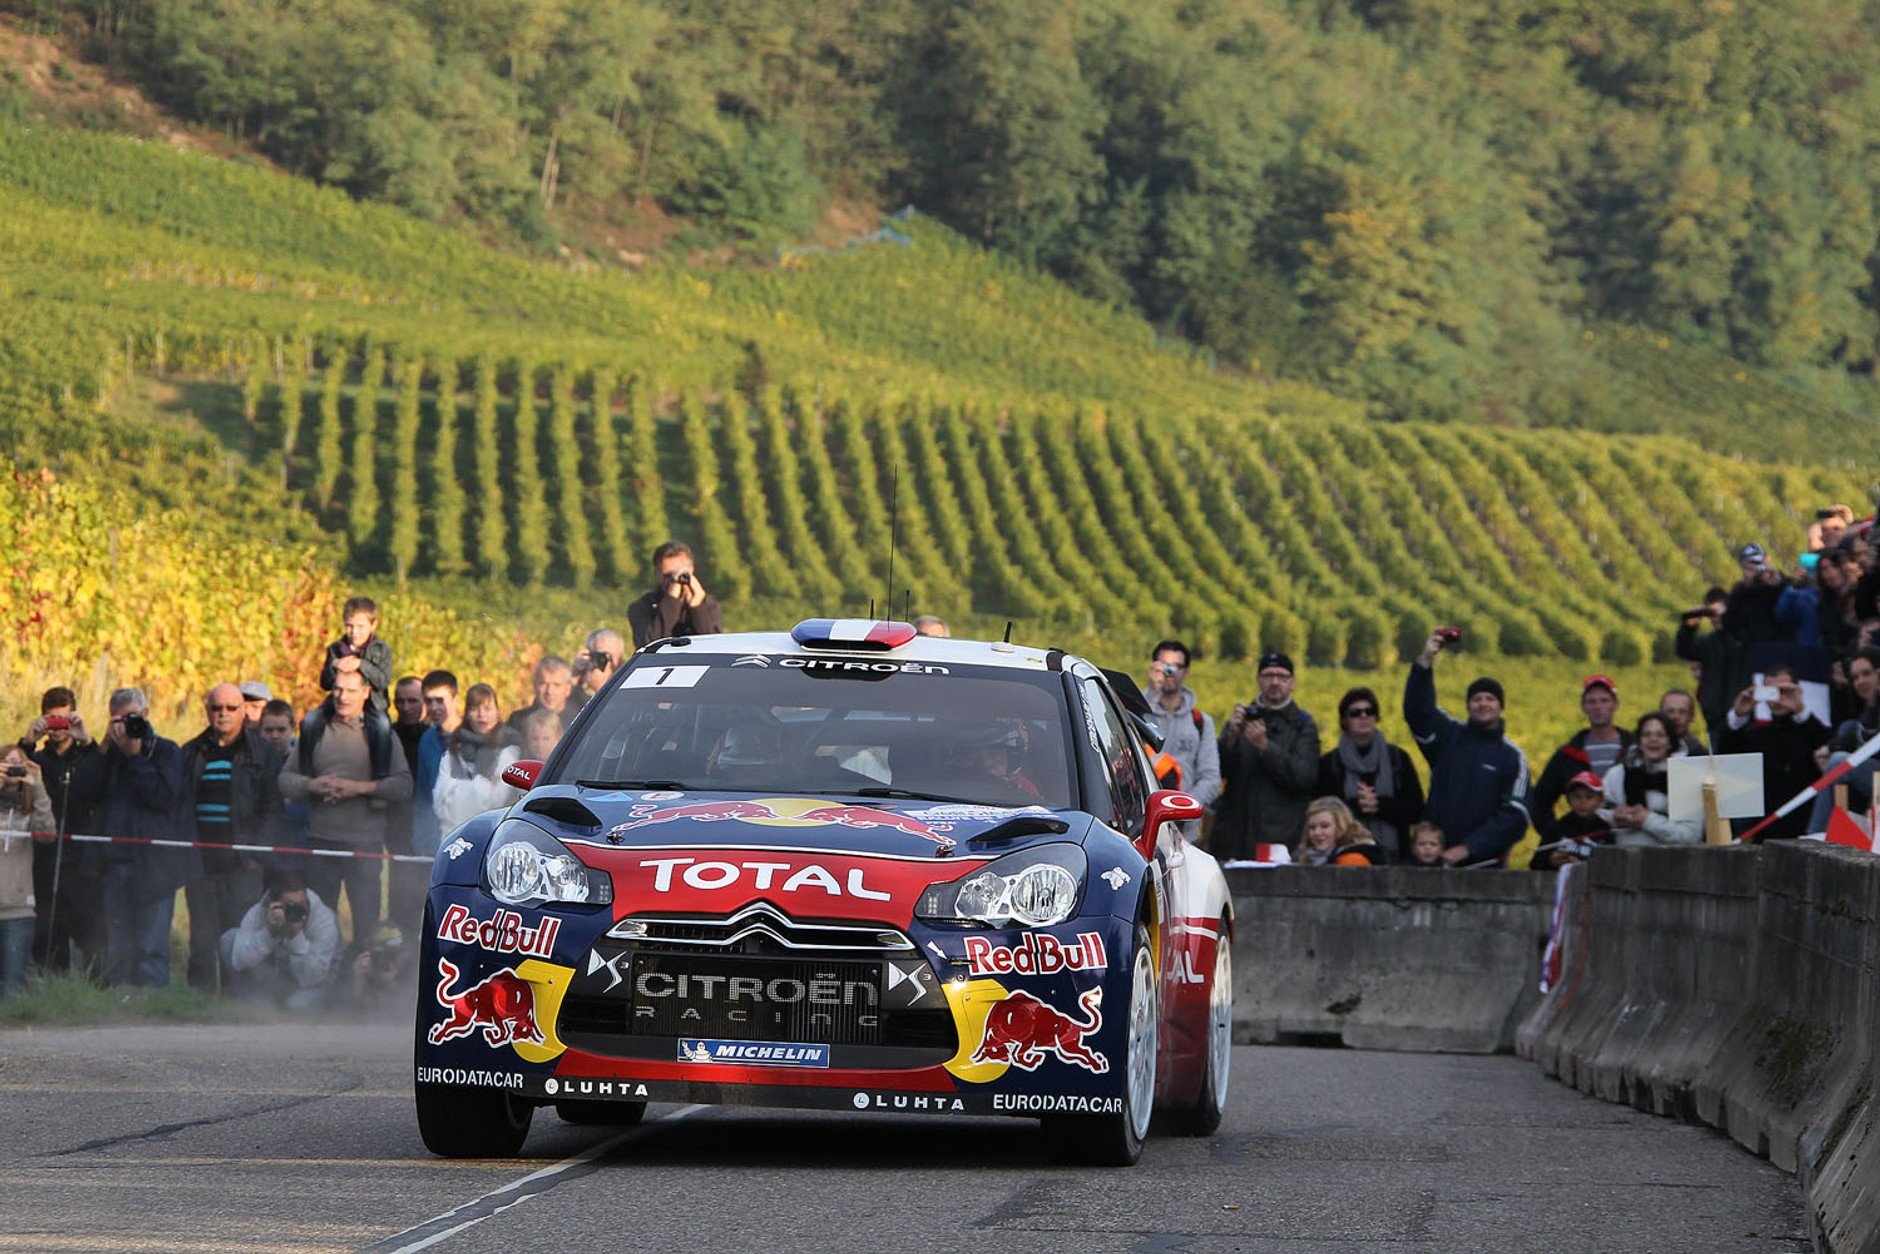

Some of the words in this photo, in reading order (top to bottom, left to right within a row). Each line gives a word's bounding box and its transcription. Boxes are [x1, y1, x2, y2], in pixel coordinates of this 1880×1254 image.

[655, 668, 675, 685] 1
[639, 857, 892, 902] TOTAL
[715, 1045, 822, 1061] MICHELIN
[417, 1067, 524, 1089] EURODATACAR
[564, 1081, 649, 1096] LUHTA
[876, 1095, 964, 1110] LUHTA
[992, 1094, 1122, 1113] EURODATACAR
